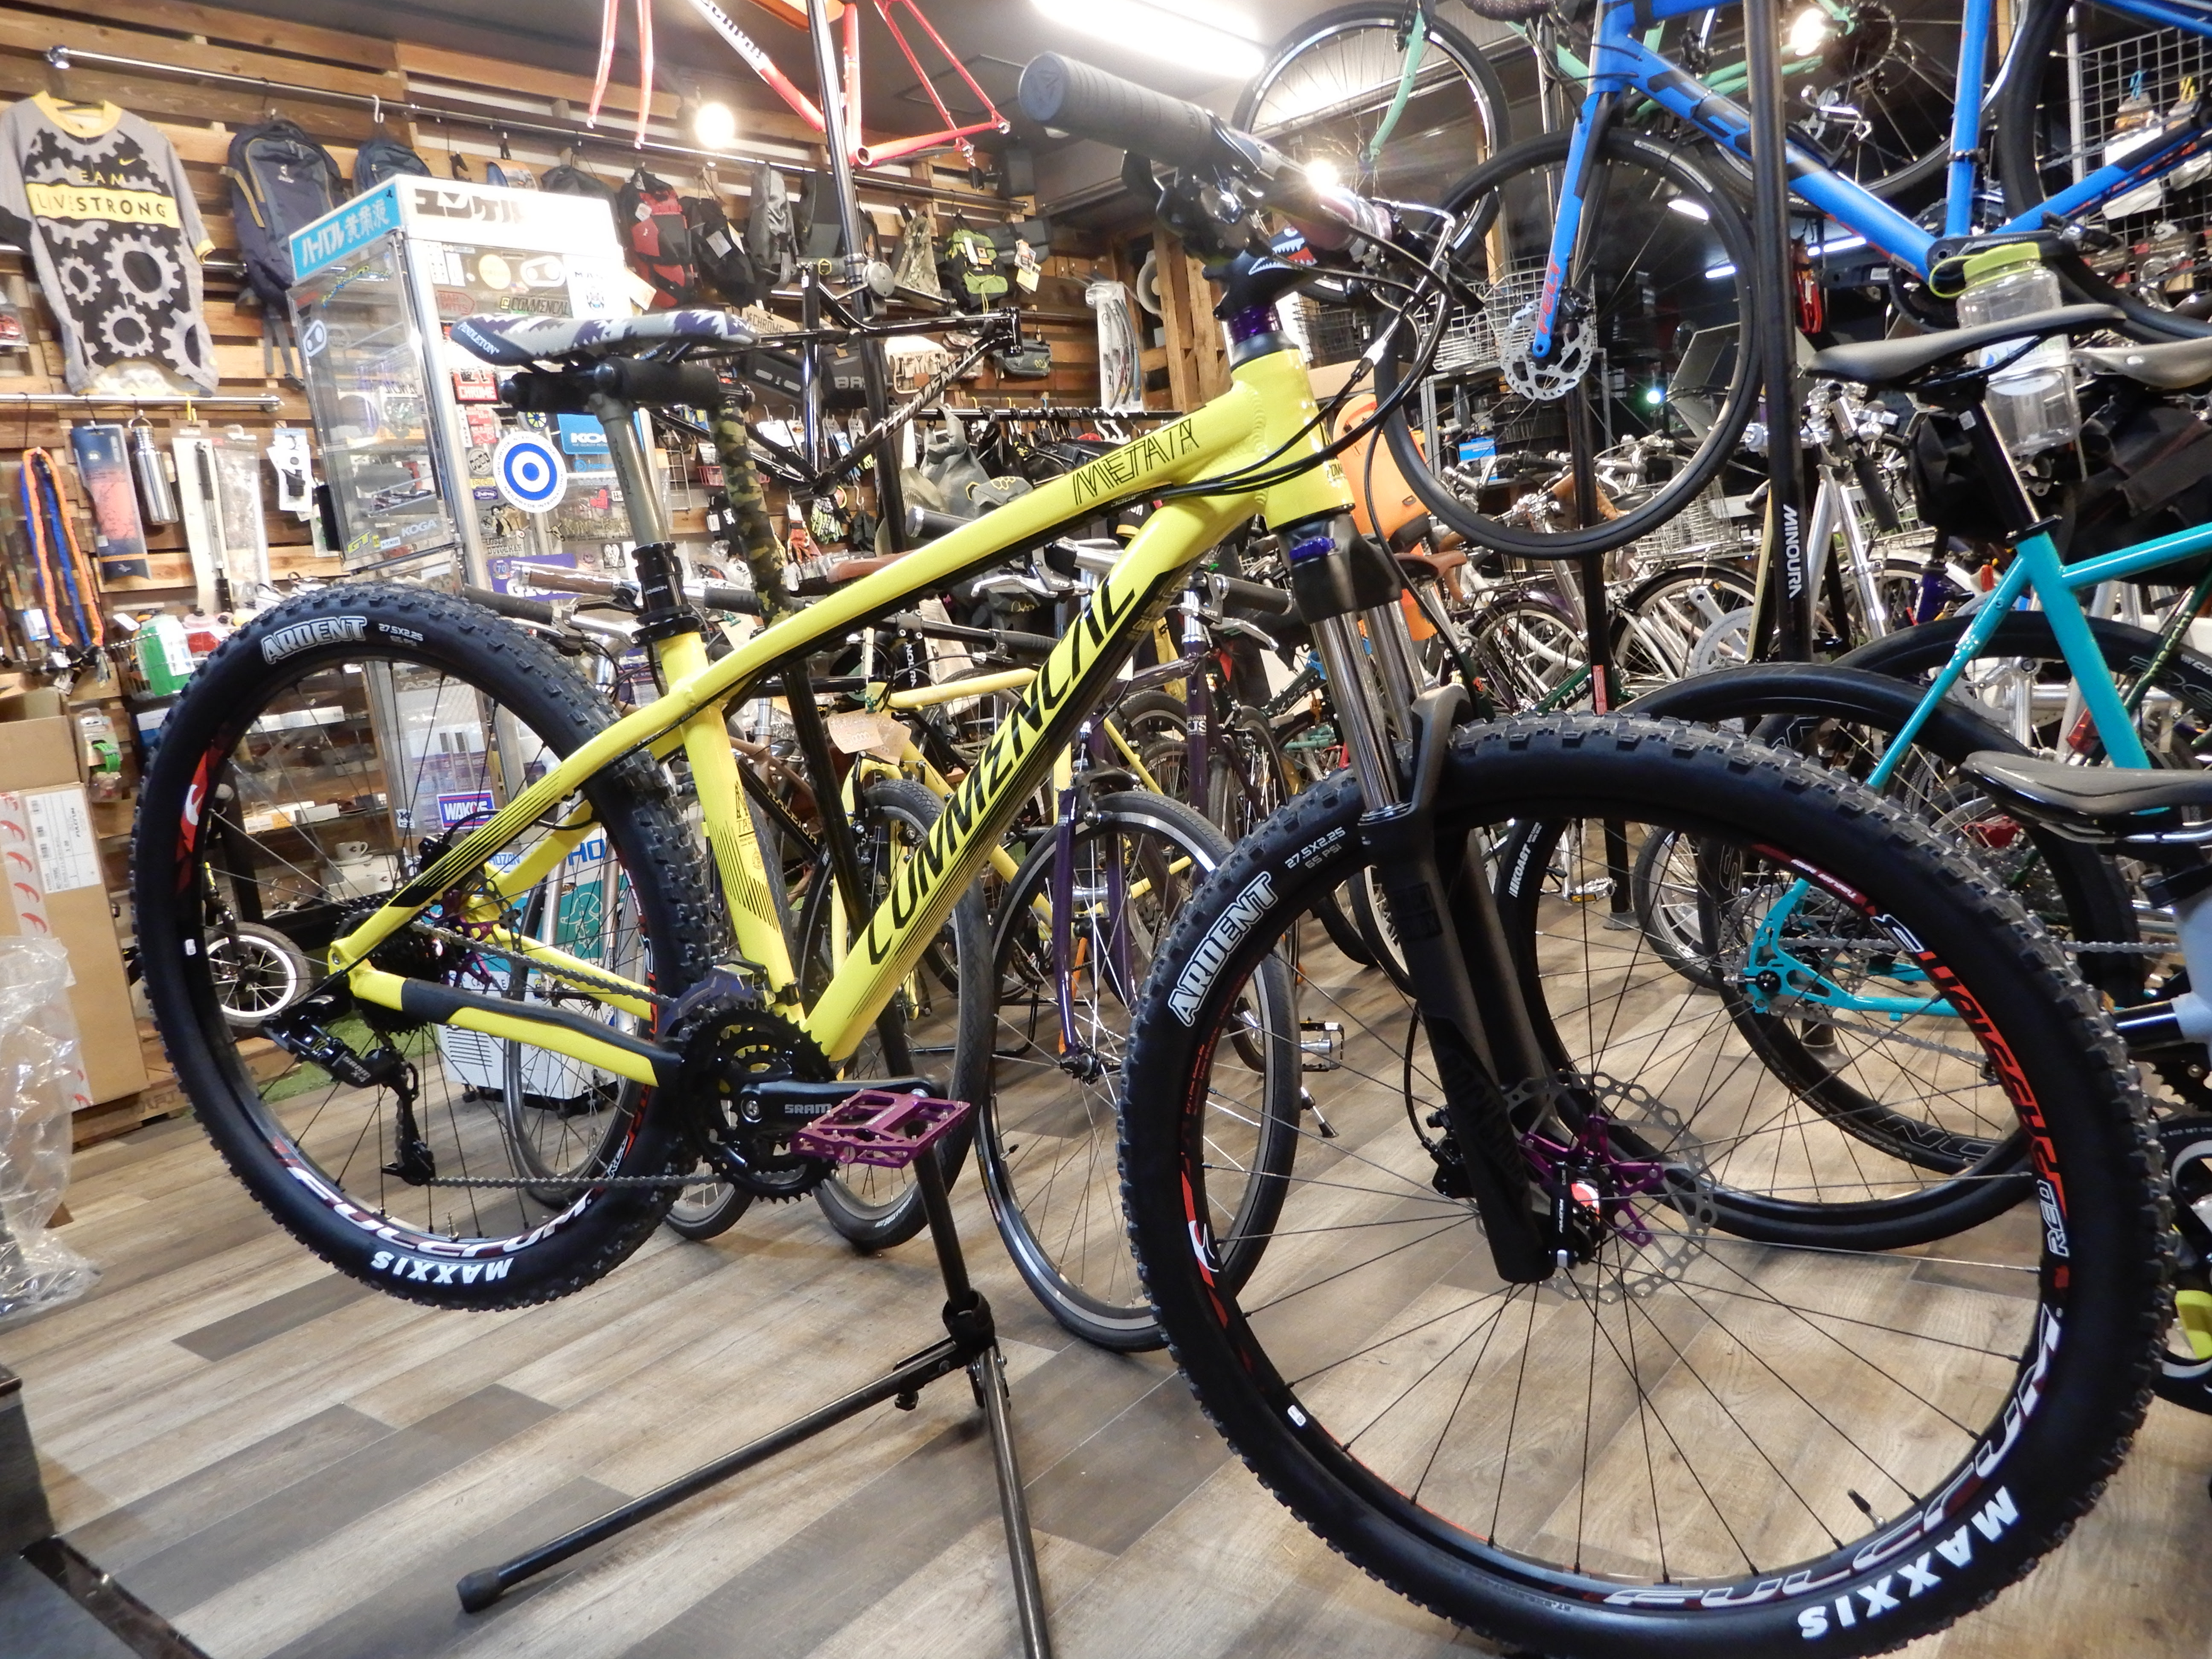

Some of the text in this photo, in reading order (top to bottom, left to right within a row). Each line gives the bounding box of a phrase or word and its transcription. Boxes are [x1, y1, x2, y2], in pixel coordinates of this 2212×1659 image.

[511, 297, 570, 315] COMMENCAL
[457, 321, 500, 355] PENDLETON
[459, 387, 497, 399] CHROME
[402, 519, 437, 536] KOGA
[1782, 504, 1802, 600] MINOURA
[260, 616, 367, 664] ARDENT
[767, 787, 818, 845] RALEIGH
[1284, 827, 1346, 869] 27.5X2.25
[1304, 843, 1343, 869] 65 PSI
[1167, 871, 1278, 1027] ARDENT
[784, 1102, 834, 1115] SRAM
[2037, 1179, 2069, 1257] RED
[370, 1250, 514, 1286] MAXXIS
[1798, 1485, 2021, 1639] MAXXIS
